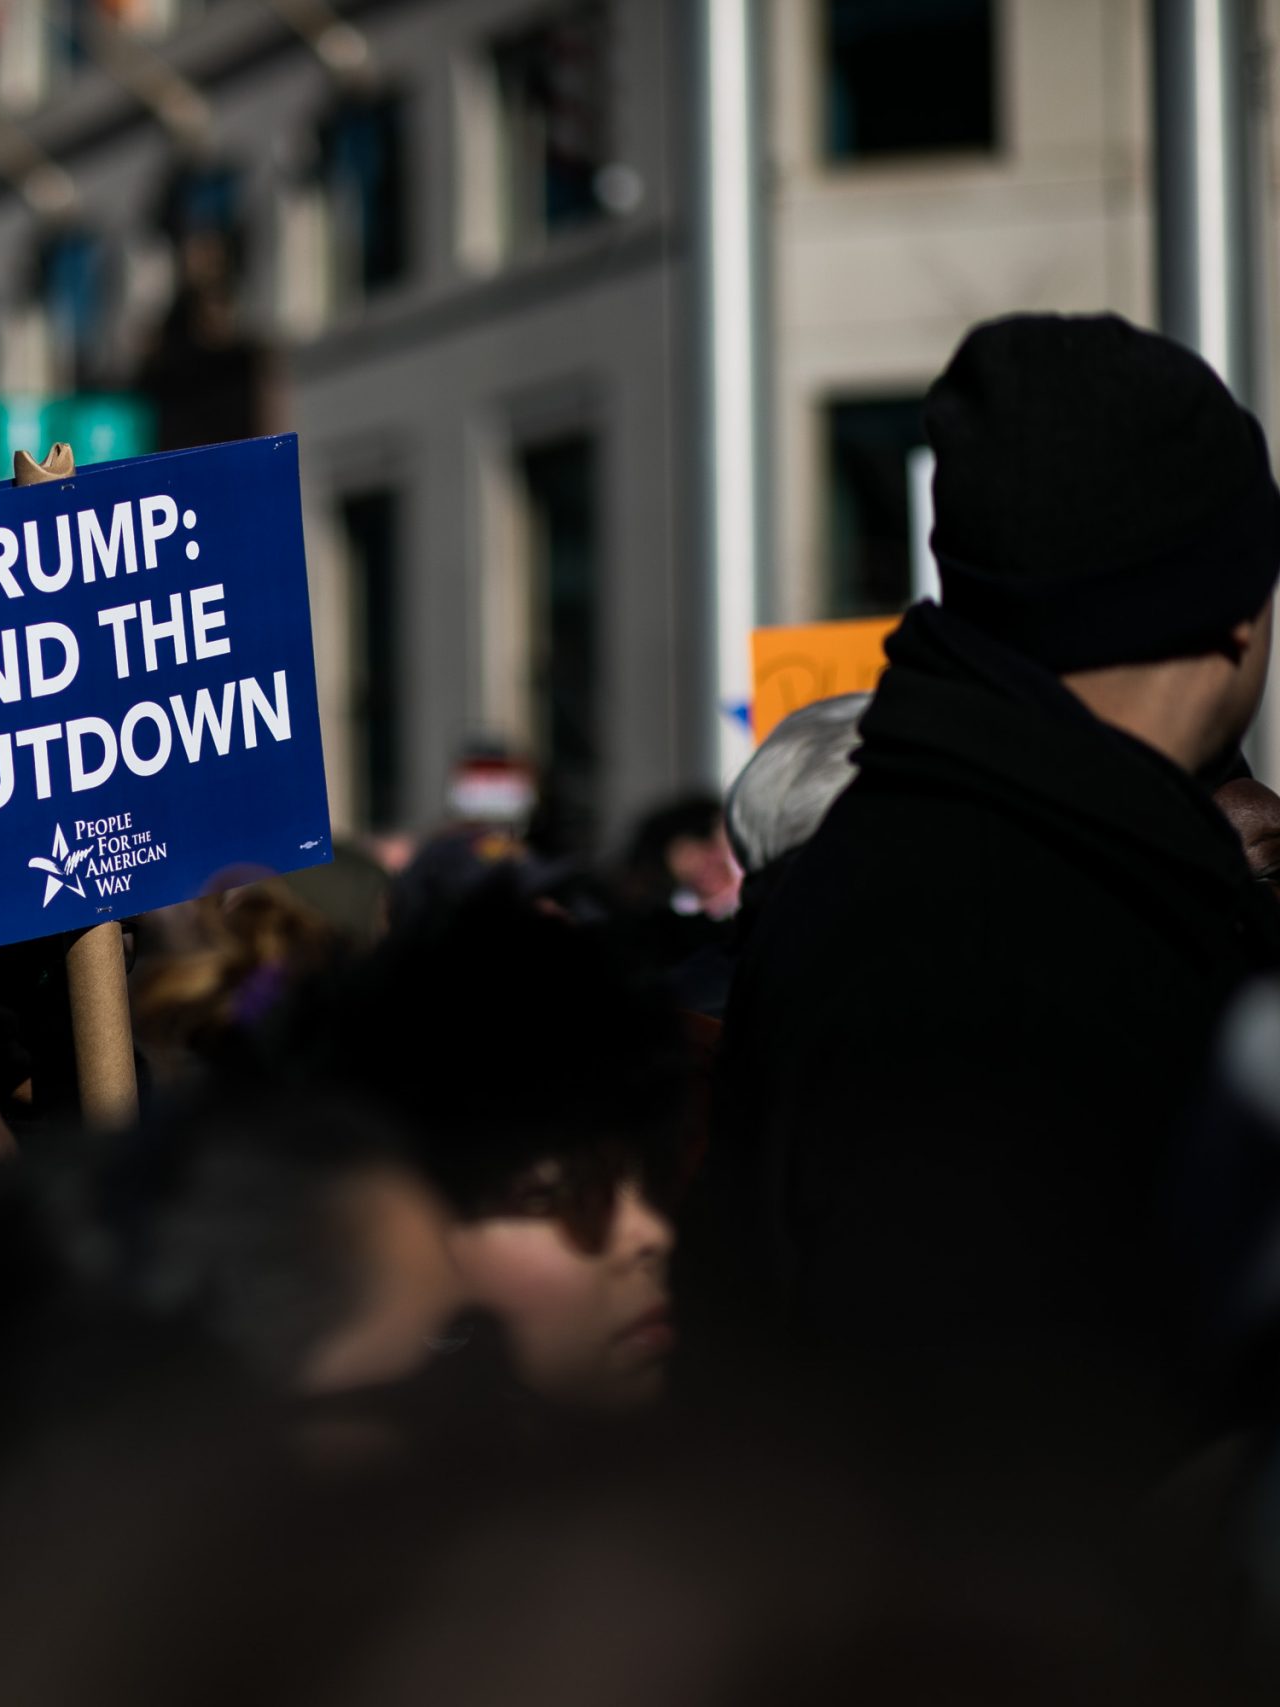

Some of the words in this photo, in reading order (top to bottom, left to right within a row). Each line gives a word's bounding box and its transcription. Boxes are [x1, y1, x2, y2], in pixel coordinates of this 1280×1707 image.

[98, 583, 231, 679] THE
[74, 812, 132, 840] PEOPLE
[97, 834, 131, 856] FOR
[132, 831, 151, 845] THE
[85, 843, 167, 878] AMERICAN
[95, 874, 132, 897] WAY
